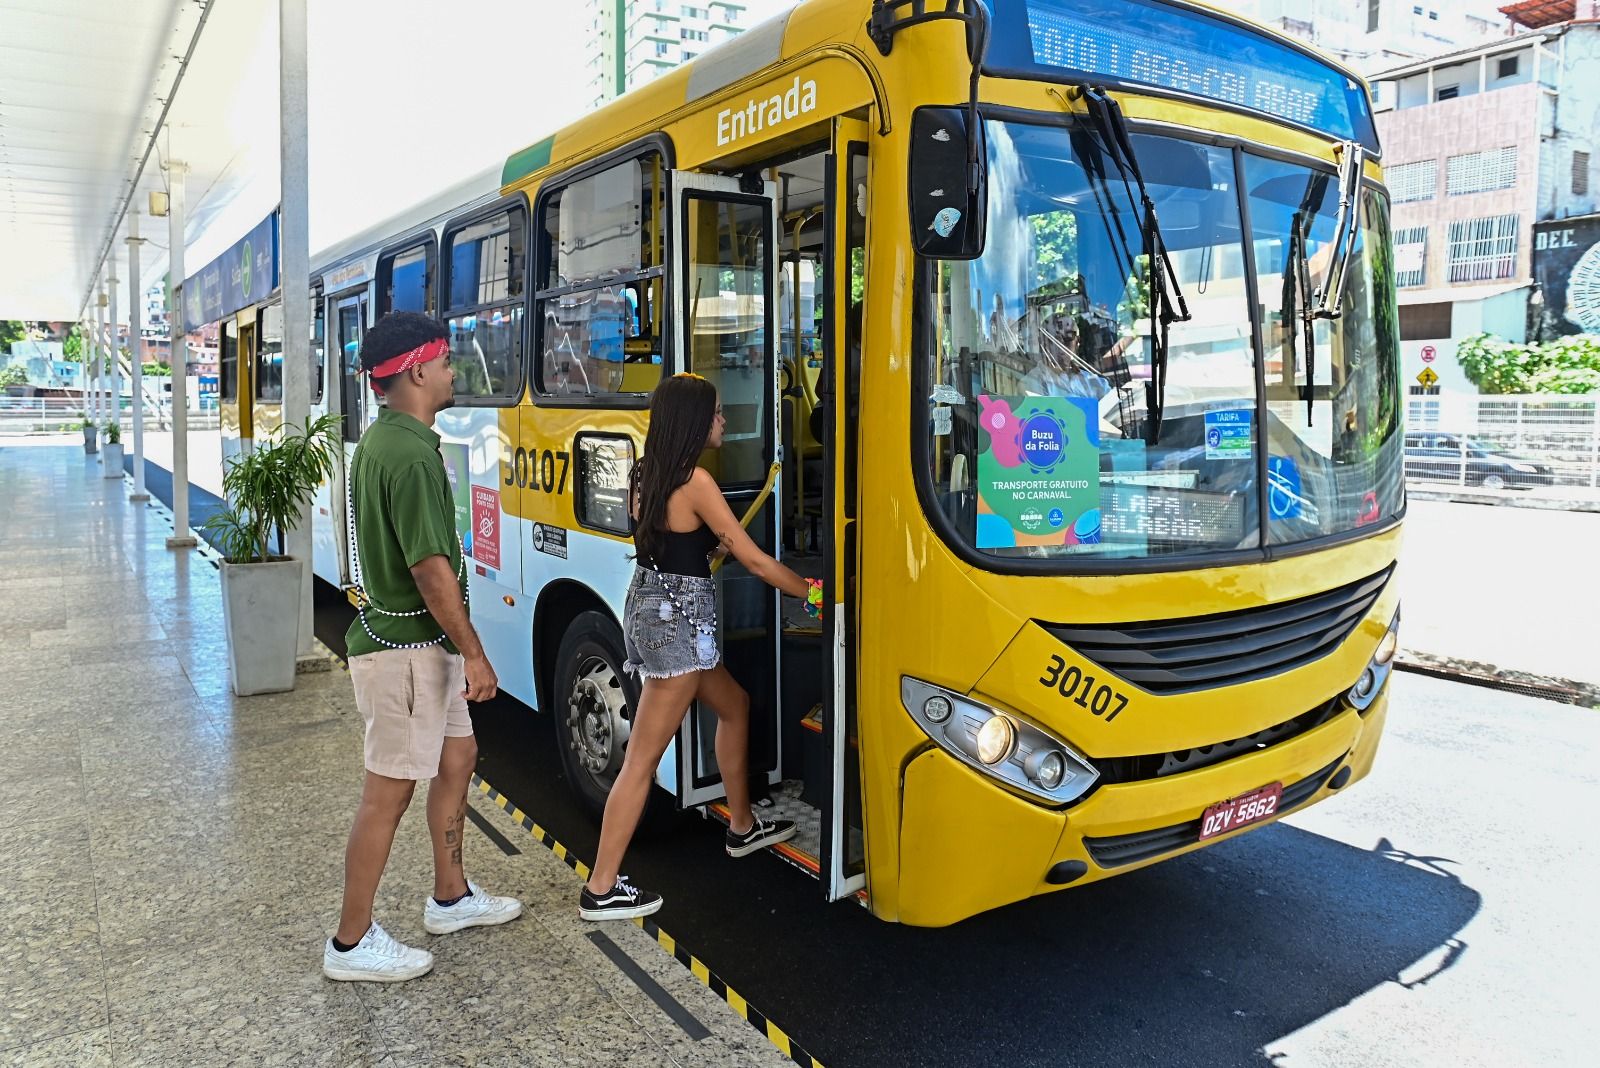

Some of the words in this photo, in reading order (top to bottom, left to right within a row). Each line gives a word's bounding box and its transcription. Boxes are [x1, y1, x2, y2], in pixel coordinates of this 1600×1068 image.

[717, 76, 817, 147] Entrada
[1216, 413, 1240, 422] TARIFA
[1031, 430, 1053, 439] Buzu
[1025, 442, 1036, 451] da
[1038, 441, 1060, 451] Folia
[503, 446, 570, 495] 30107
[992, 481, 1047, 490] TRANSPORTE
[1049, 480, 1089, 489] GRATUITO
[1012, 492, 1025, 500] NO
[1112, 493, 1180, 514] LAPA
[1102, 514, 1204, 536] ALABAR
[1039, 654, 1129, 723] 30107
